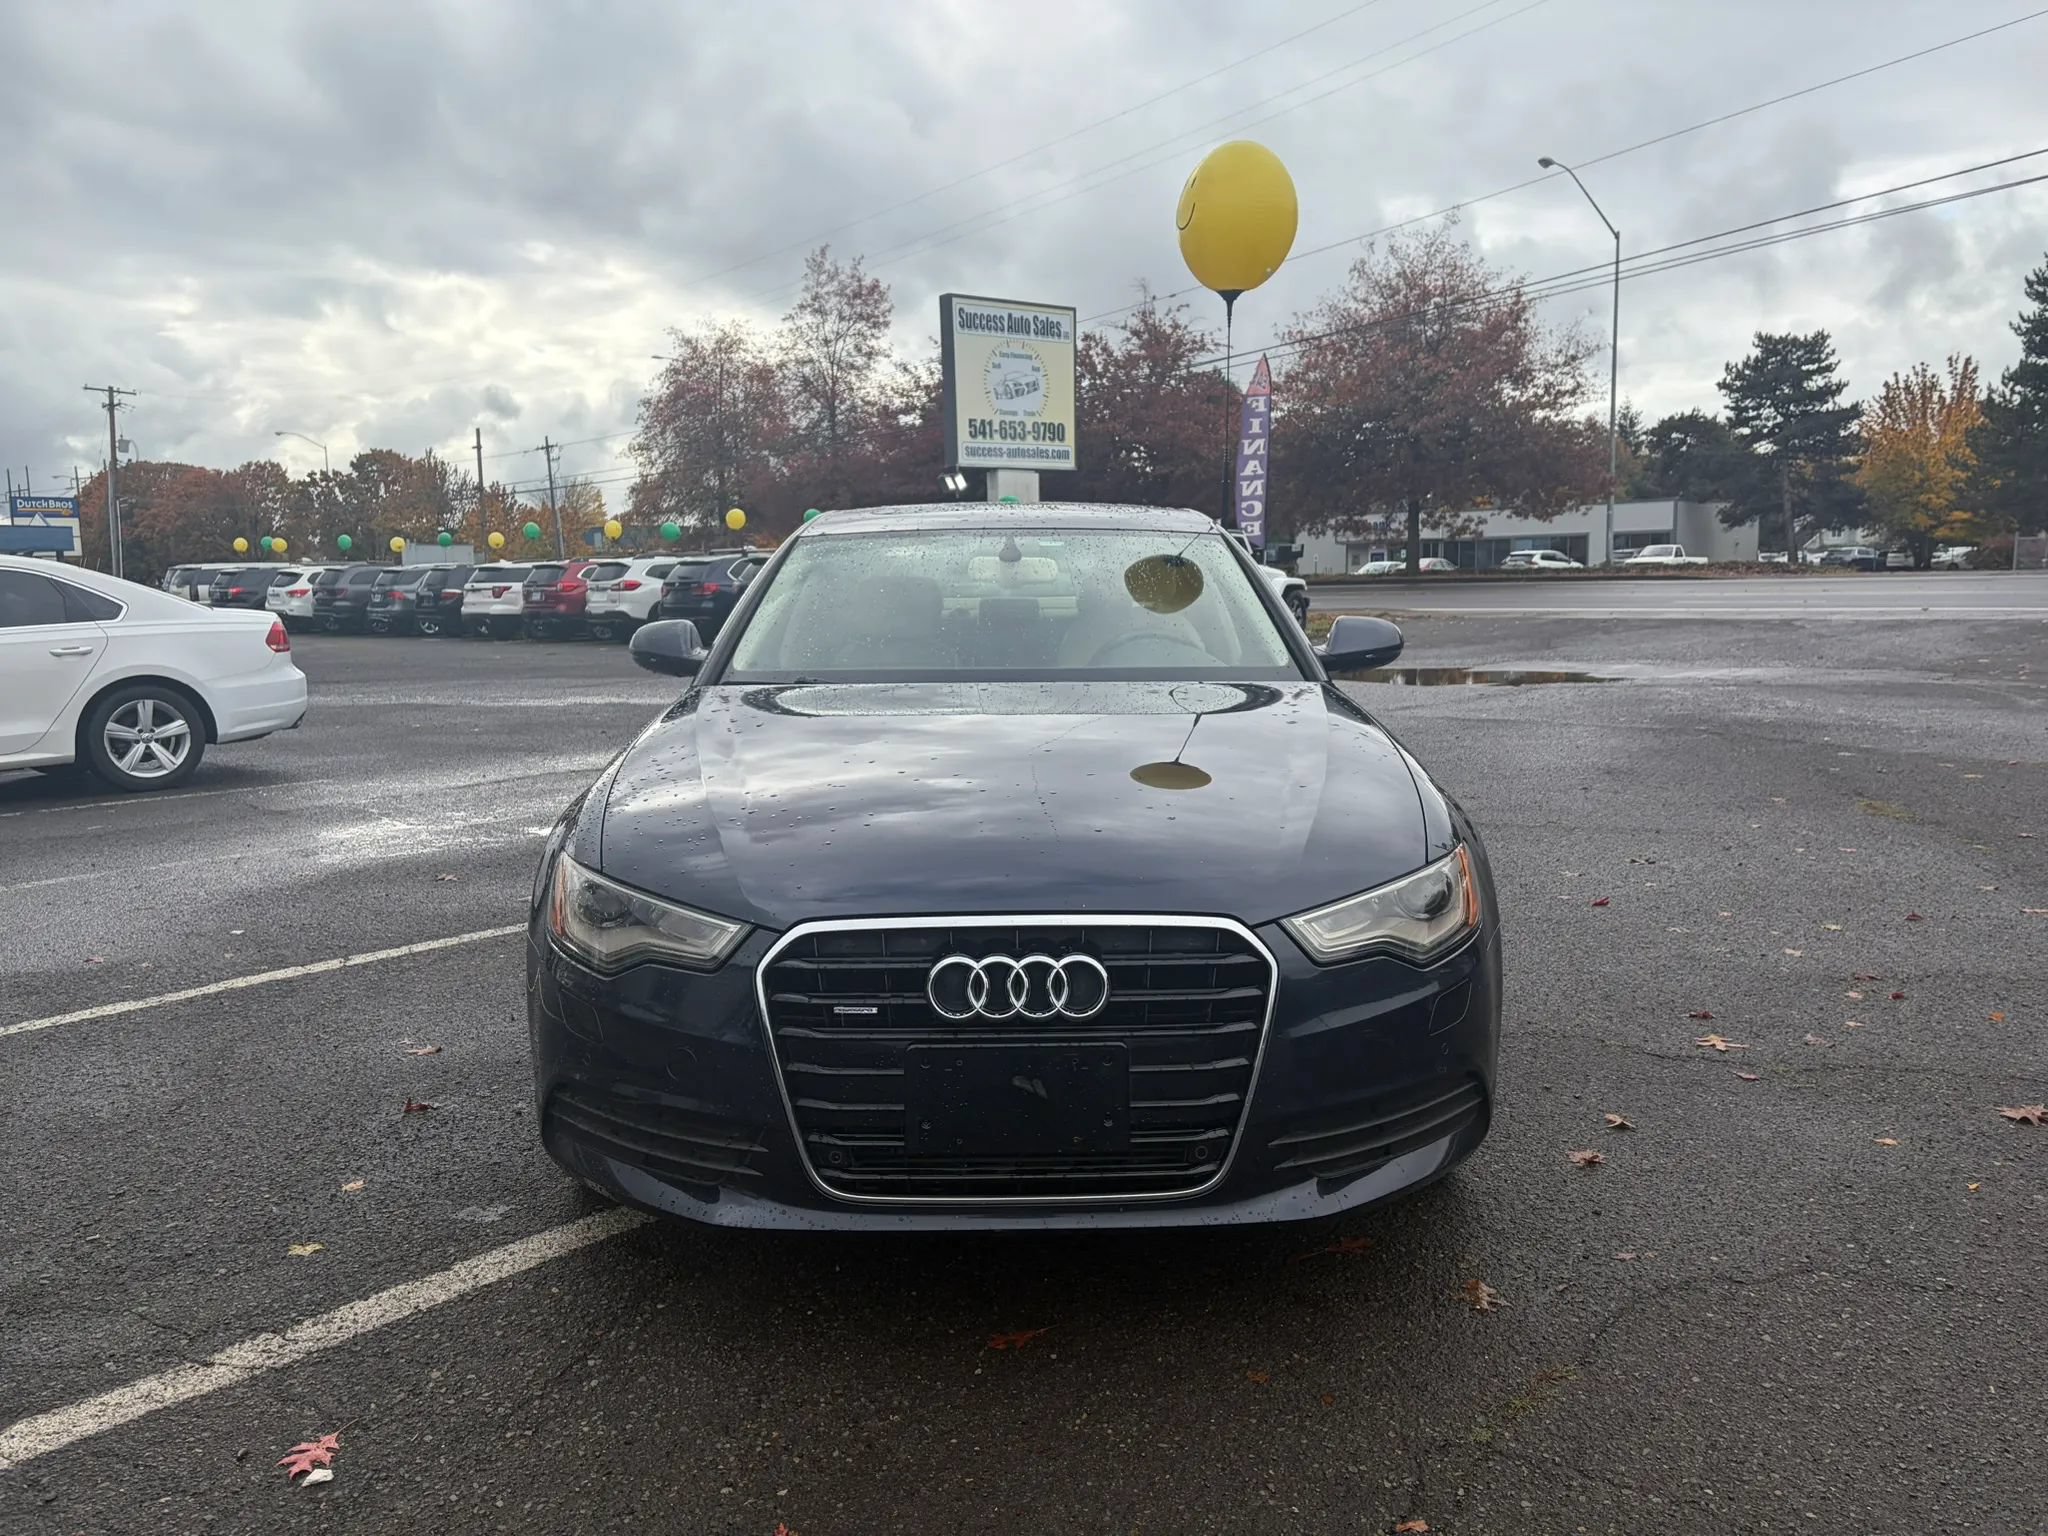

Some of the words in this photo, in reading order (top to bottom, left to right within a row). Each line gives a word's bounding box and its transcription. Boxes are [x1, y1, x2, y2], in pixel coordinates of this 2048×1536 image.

[958, 307, 1005, 334] Success
[1007, 312, 1031, 335] Auto
[1033, 315, 1062, 339] Sales
[968, 418, 1066, 442] 541-653-9790
[964, 445, 1070, 460] success-autosales.com
[48, 499, 73, 509] BROS
